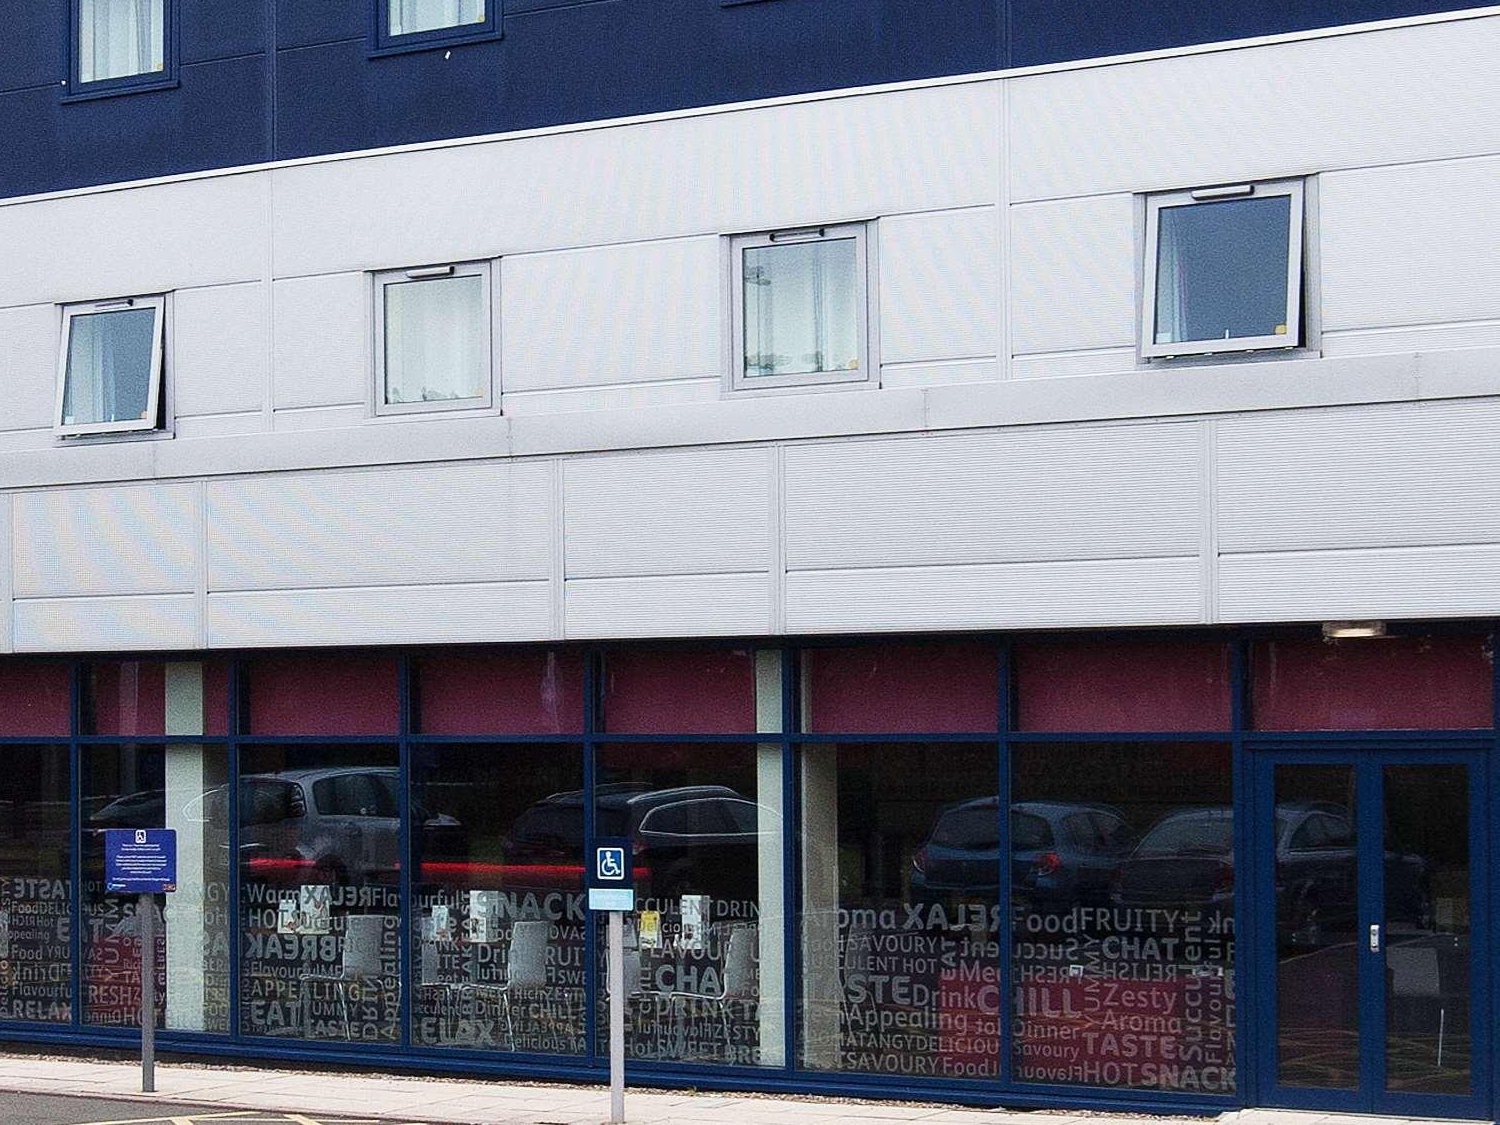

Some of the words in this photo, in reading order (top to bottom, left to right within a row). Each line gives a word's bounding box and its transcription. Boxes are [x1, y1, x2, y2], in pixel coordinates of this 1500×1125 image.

[246, 883, 299, 904] Warm
[1080, 906, 1180, 934] FRUITY
[849, 934, 938, 955] SAVOURY
[1101, 935, 1180, 962] CHAT
[902, 957, 938, 974] HOT
[12, 982, 73, 999] Flavourfu
[250, 978, 361, 1002] APPEALING
[912, 983, 978, 1009] Drink
[1102, 982, 1178, 1015] Zesty
[250, 1000, 299, 1026] EAT
[850, 1003, 968, 1036] Appealing
[1101, 1008, 1183, 1035] Aroma
[855, 1032, 917, 1052] TANGY
[916, 1034, 1000, 1055] DELICIOU
[1013, 1040, 1081, 1063] Savoury
[1081, 1032, 1179, 1060] TASTE
[846, 1051, 940, 1075] SAVOURY
[942, 1057, 989, 1077] Food
[1083, 1060, 1139, 1086] HOT
[1140, 1063, 1237, 1091] SNACK
